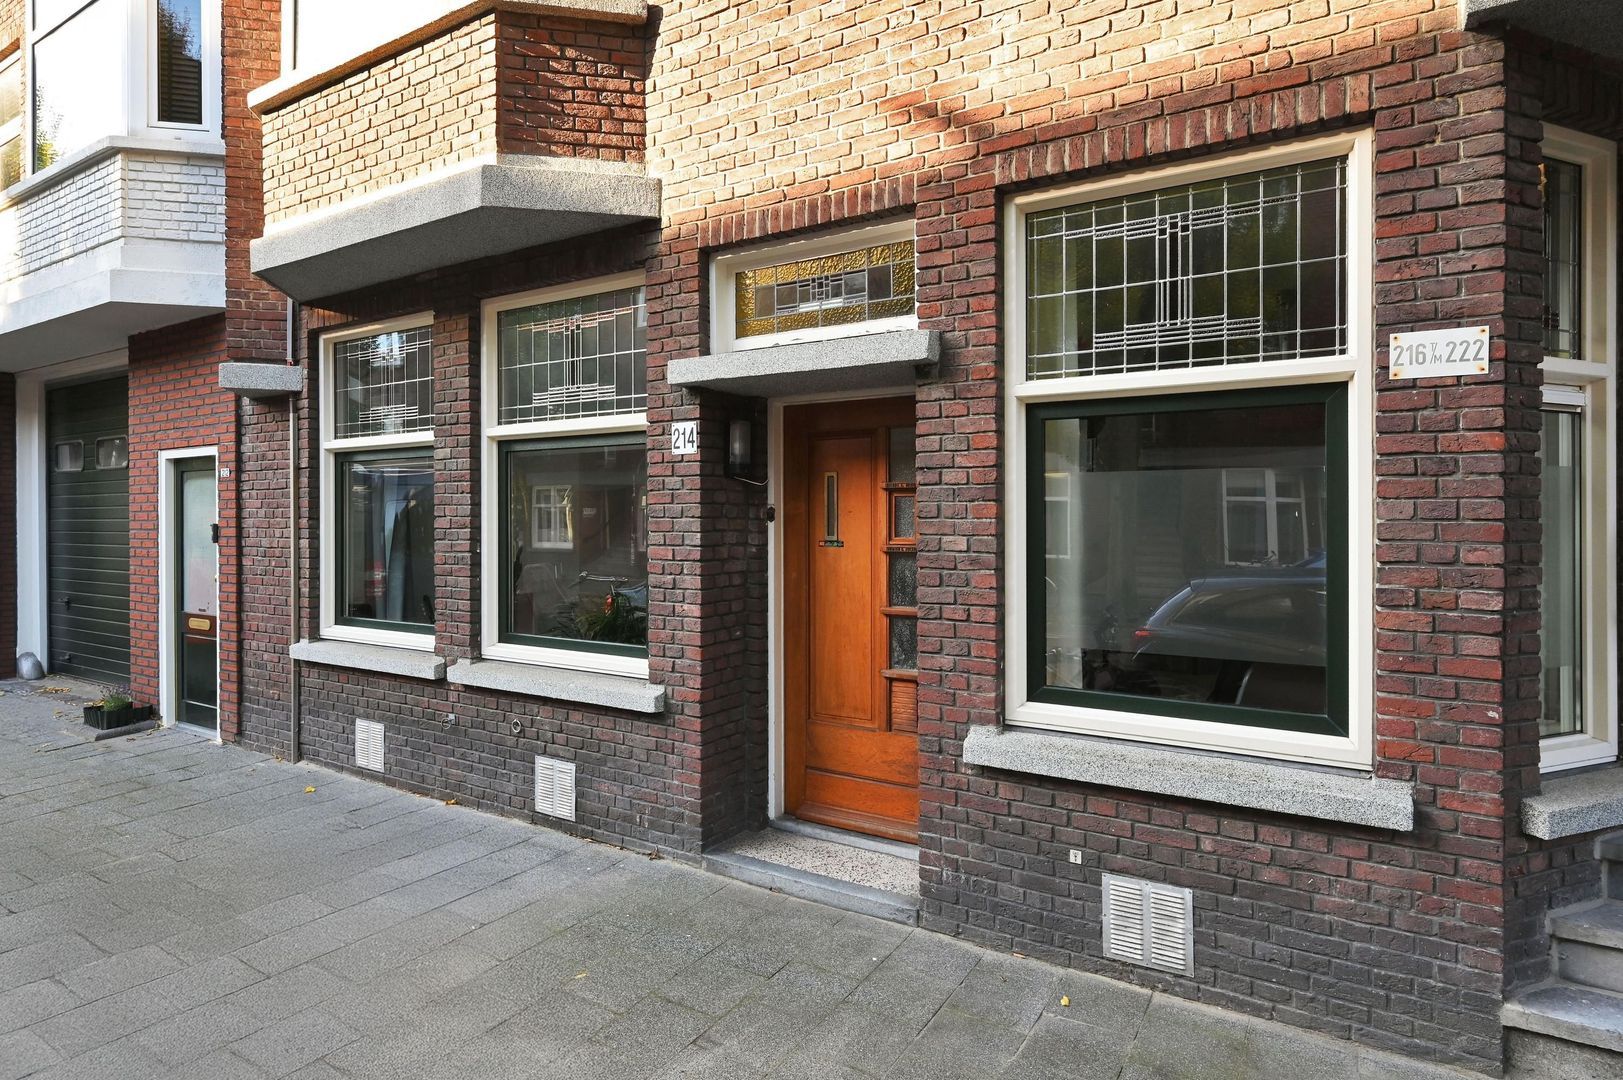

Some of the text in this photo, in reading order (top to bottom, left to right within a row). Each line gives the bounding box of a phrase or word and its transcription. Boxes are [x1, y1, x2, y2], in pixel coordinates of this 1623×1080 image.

[1393, 343, 1427, 367] 216
[1445, 338, 1485, 363] 222
[673, 427, 695, 449] 214
